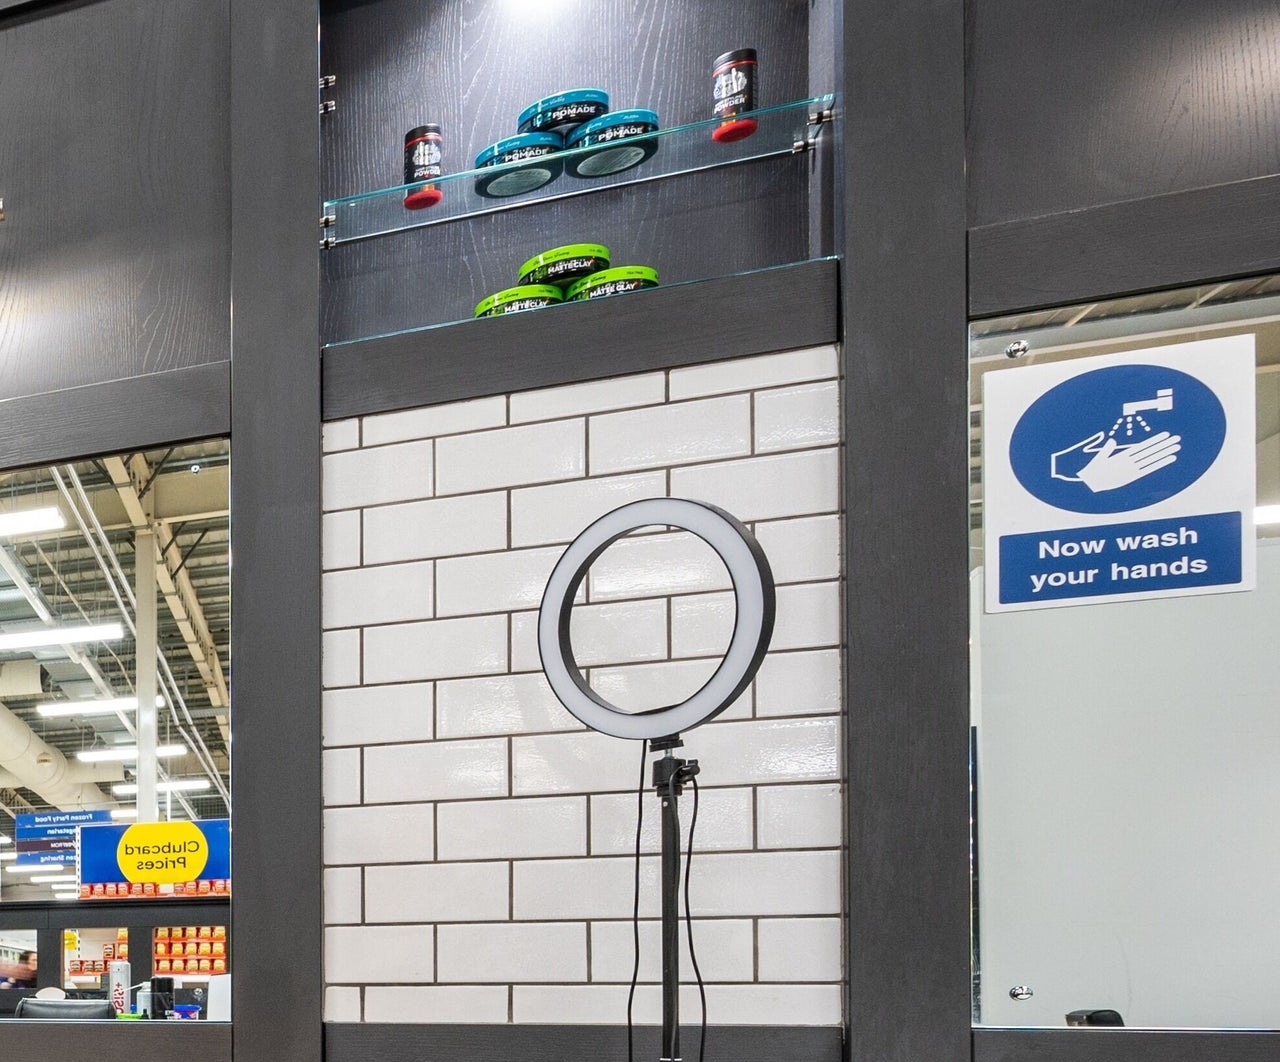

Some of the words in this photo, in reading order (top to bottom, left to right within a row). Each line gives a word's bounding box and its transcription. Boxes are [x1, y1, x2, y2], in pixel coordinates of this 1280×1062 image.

[552, 105, 596, 119] POMADE
[598, 127, 643, 142] POMADE
[590, 285, 615, 297] MATTE
[616, 284, 636, 294] CLAY
[1038, 537, 1106, 559] Now
[1116, 526, 1198, 550] wash
[1029, 567, 1099, 592] your
[1110, 556, 1208, 581] hands
